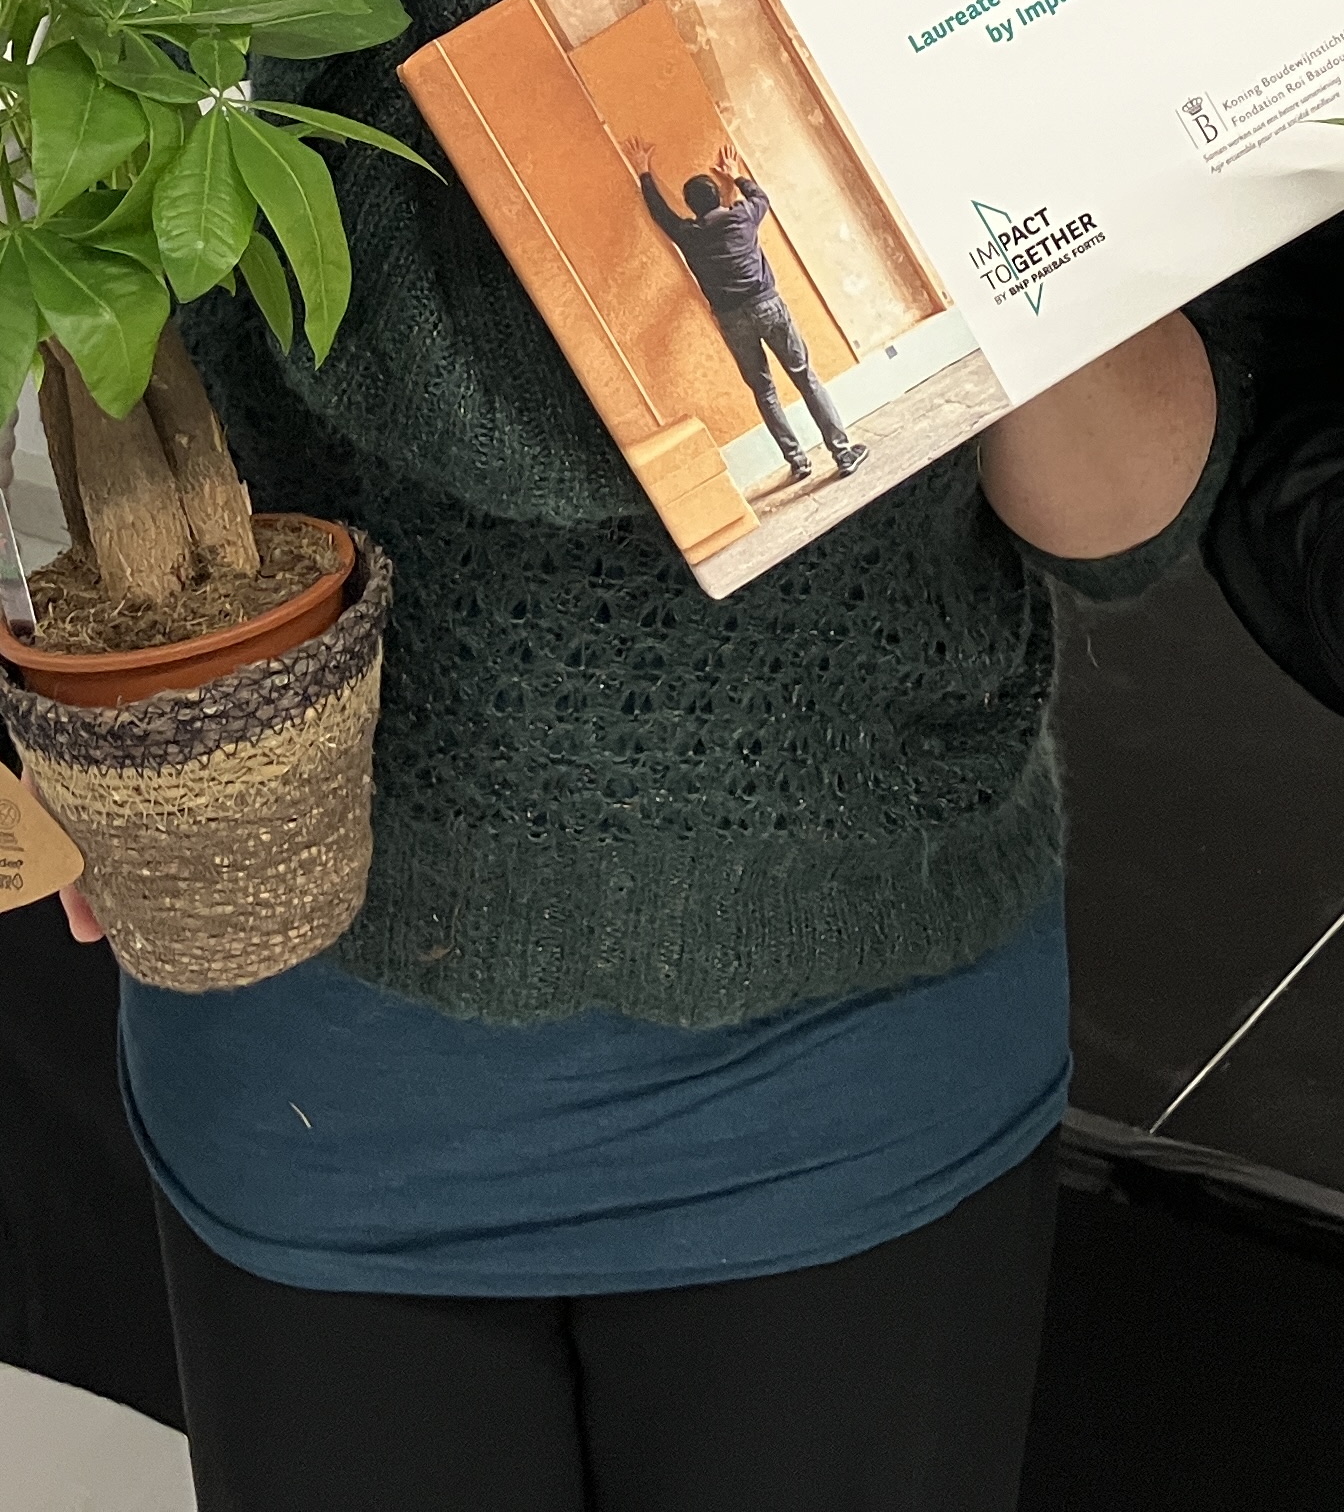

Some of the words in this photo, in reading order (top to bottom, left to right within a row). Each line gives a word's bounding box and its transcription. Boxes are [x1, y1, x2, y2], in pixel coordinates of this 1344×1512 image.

[985, 16, 1015, 44] by
[1222, 84, 1263, 112] Koning
[1230, 91, 1286, 128] Fondation
[1285, 78, 1306, 94] Roi
[968, 207, 1051, 270] IMPACT
[980, 212, 1098, 291] TOGETHER
[993, 291, 1008, 306] BY
[1008, 278, 1030, 297] BNP
[1030, 253, 1072, 283] PARIBAS
[1071, 231, 1106, 258] FORTIS
